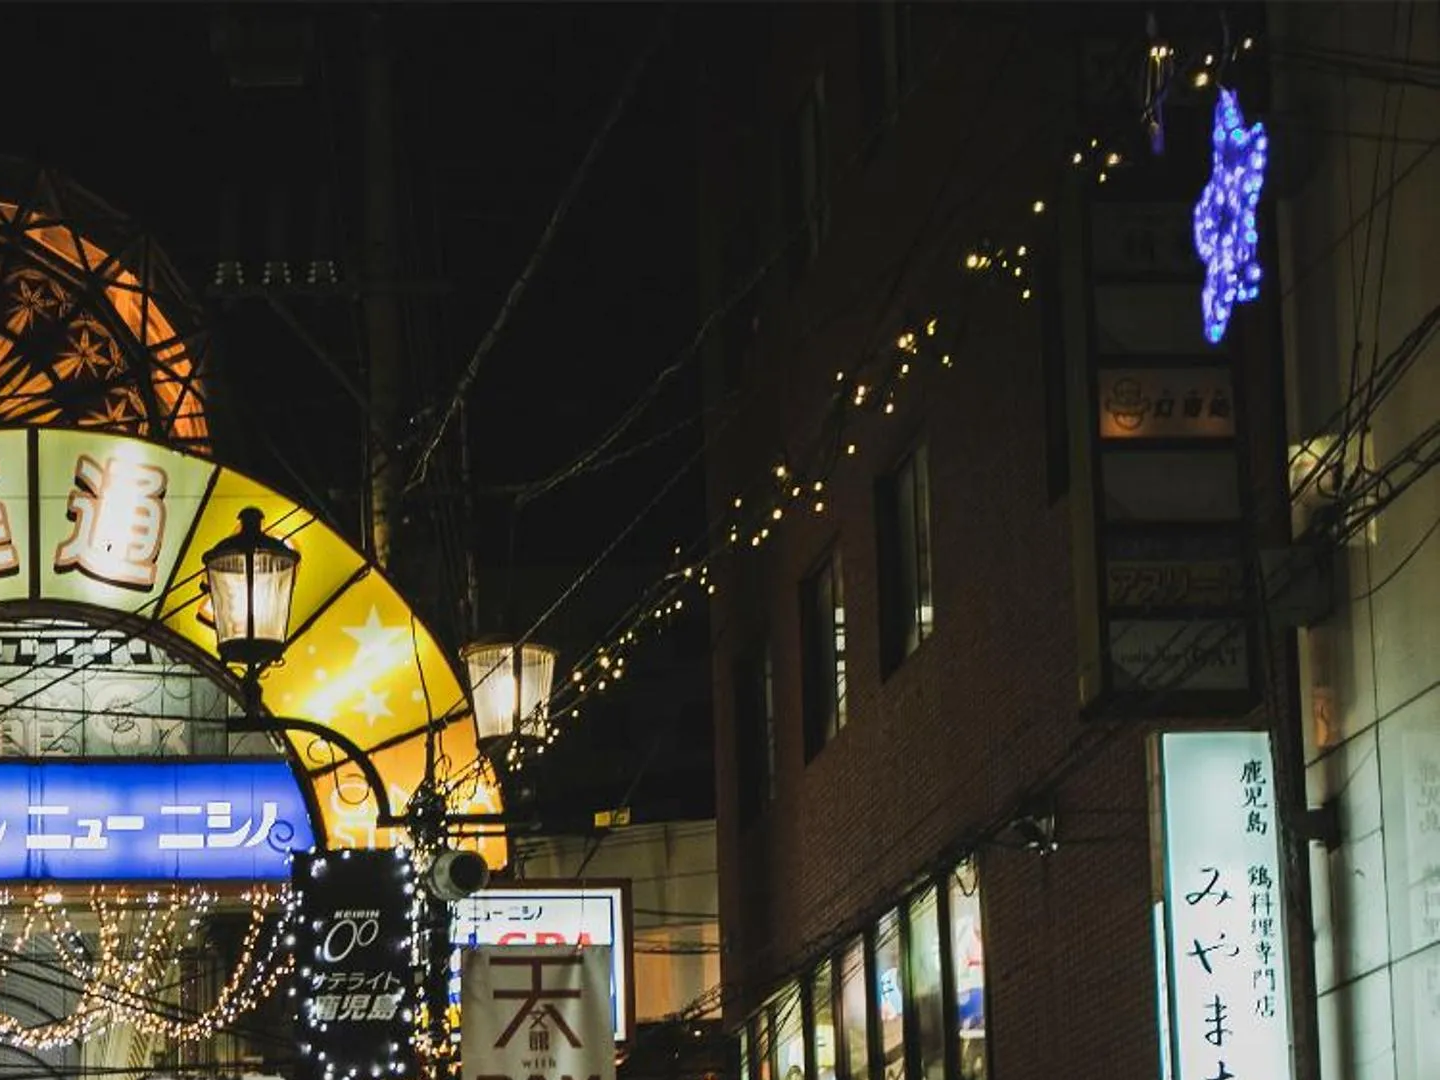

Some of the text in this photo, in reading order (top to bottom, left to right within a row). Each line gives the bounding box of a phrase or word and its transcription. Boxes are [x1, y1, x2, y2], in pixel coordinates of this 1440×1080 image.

[27, 808, 144, 848] ニュー
[159, 802, 281, 849] ニシノ
[1240, 760, 1276, 1017] 鹿児島 鶏料理専門店
[312, 971, 401, 990] サテライト
[315, 993, 399, 1021] 鹿児島
[521, 1057, 557, 1069] with
